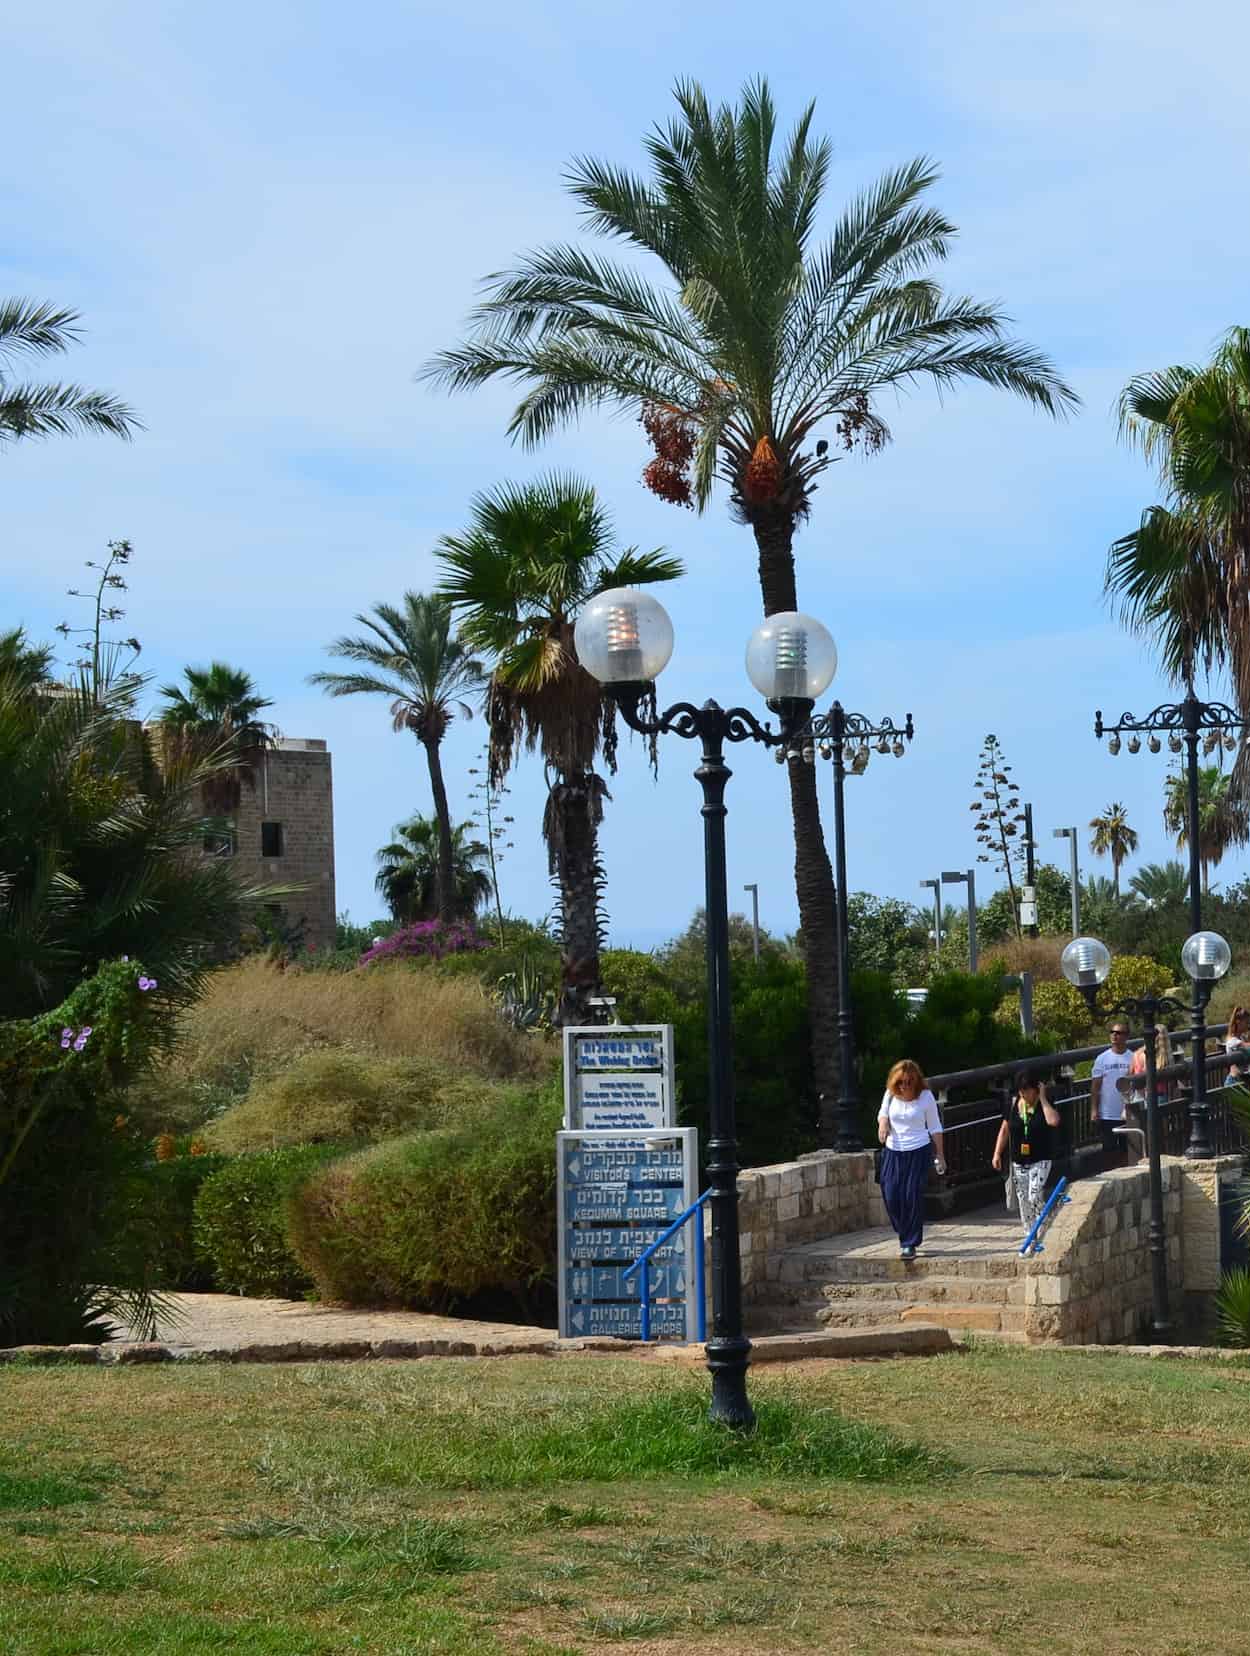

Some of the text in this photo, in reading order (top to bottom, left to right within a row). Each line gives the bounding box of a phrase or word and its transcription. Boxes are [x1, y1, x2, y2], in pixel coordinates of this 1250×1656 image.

[580, 1056, 596, 1065] The
[583, 1152, 683, 1168] מרכז מבקרים
[583, 1167, 683, 1180] VISITOR'S CENTER
[577, 1190, 663, 1206] ככר קדומים
[626, 1207, 668, 1219] SQUARE
[575, 1229, 612, 1245] לנמל
[571, 1246, 673, 1258] VIEW OF THE ORT
[590, 1307, 630, 1321] חנויות
[650, 1322, 682, 1334] SHOPS
